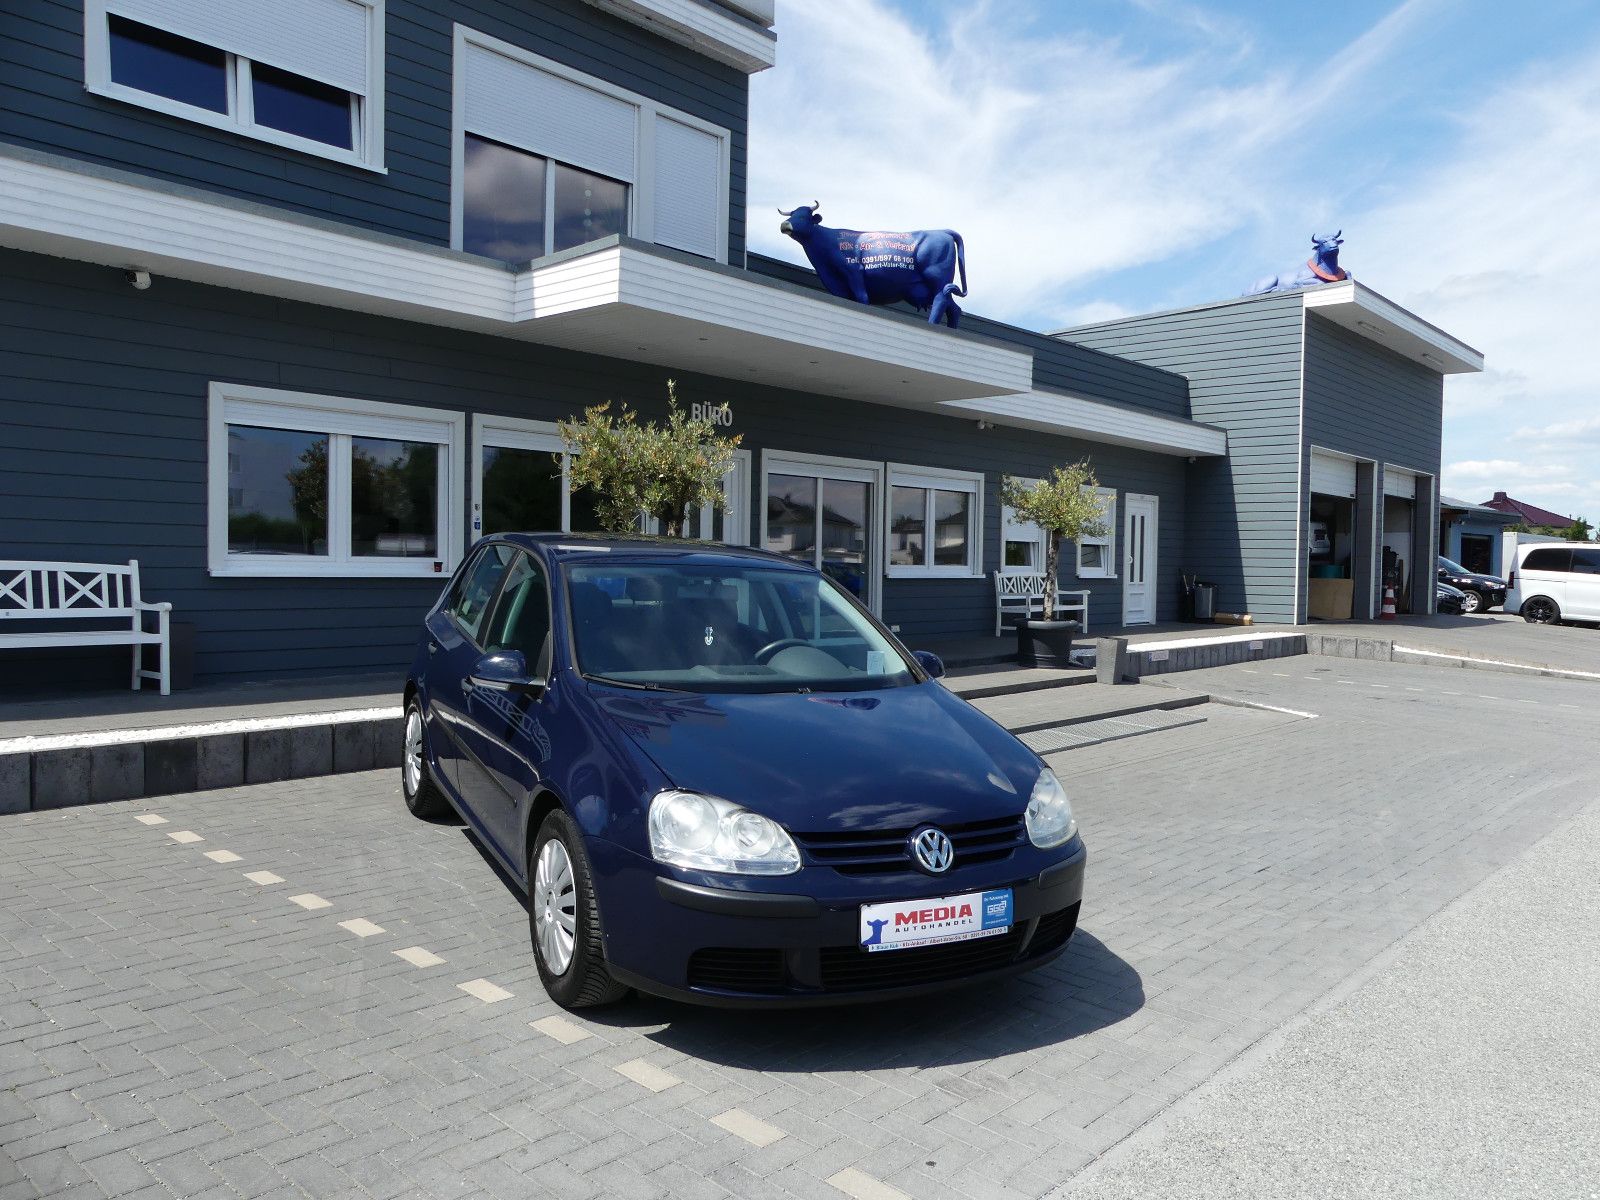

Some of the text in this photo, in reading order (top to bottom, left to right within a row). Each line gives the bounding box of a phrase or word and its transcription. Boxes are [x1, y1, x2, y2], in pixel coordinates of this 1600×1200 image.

[691, 400, 733, 427] BÜRO
[895, 903, 973, 926] MEDIA
[895, 918, 973, 933] AUTOHANDEL
